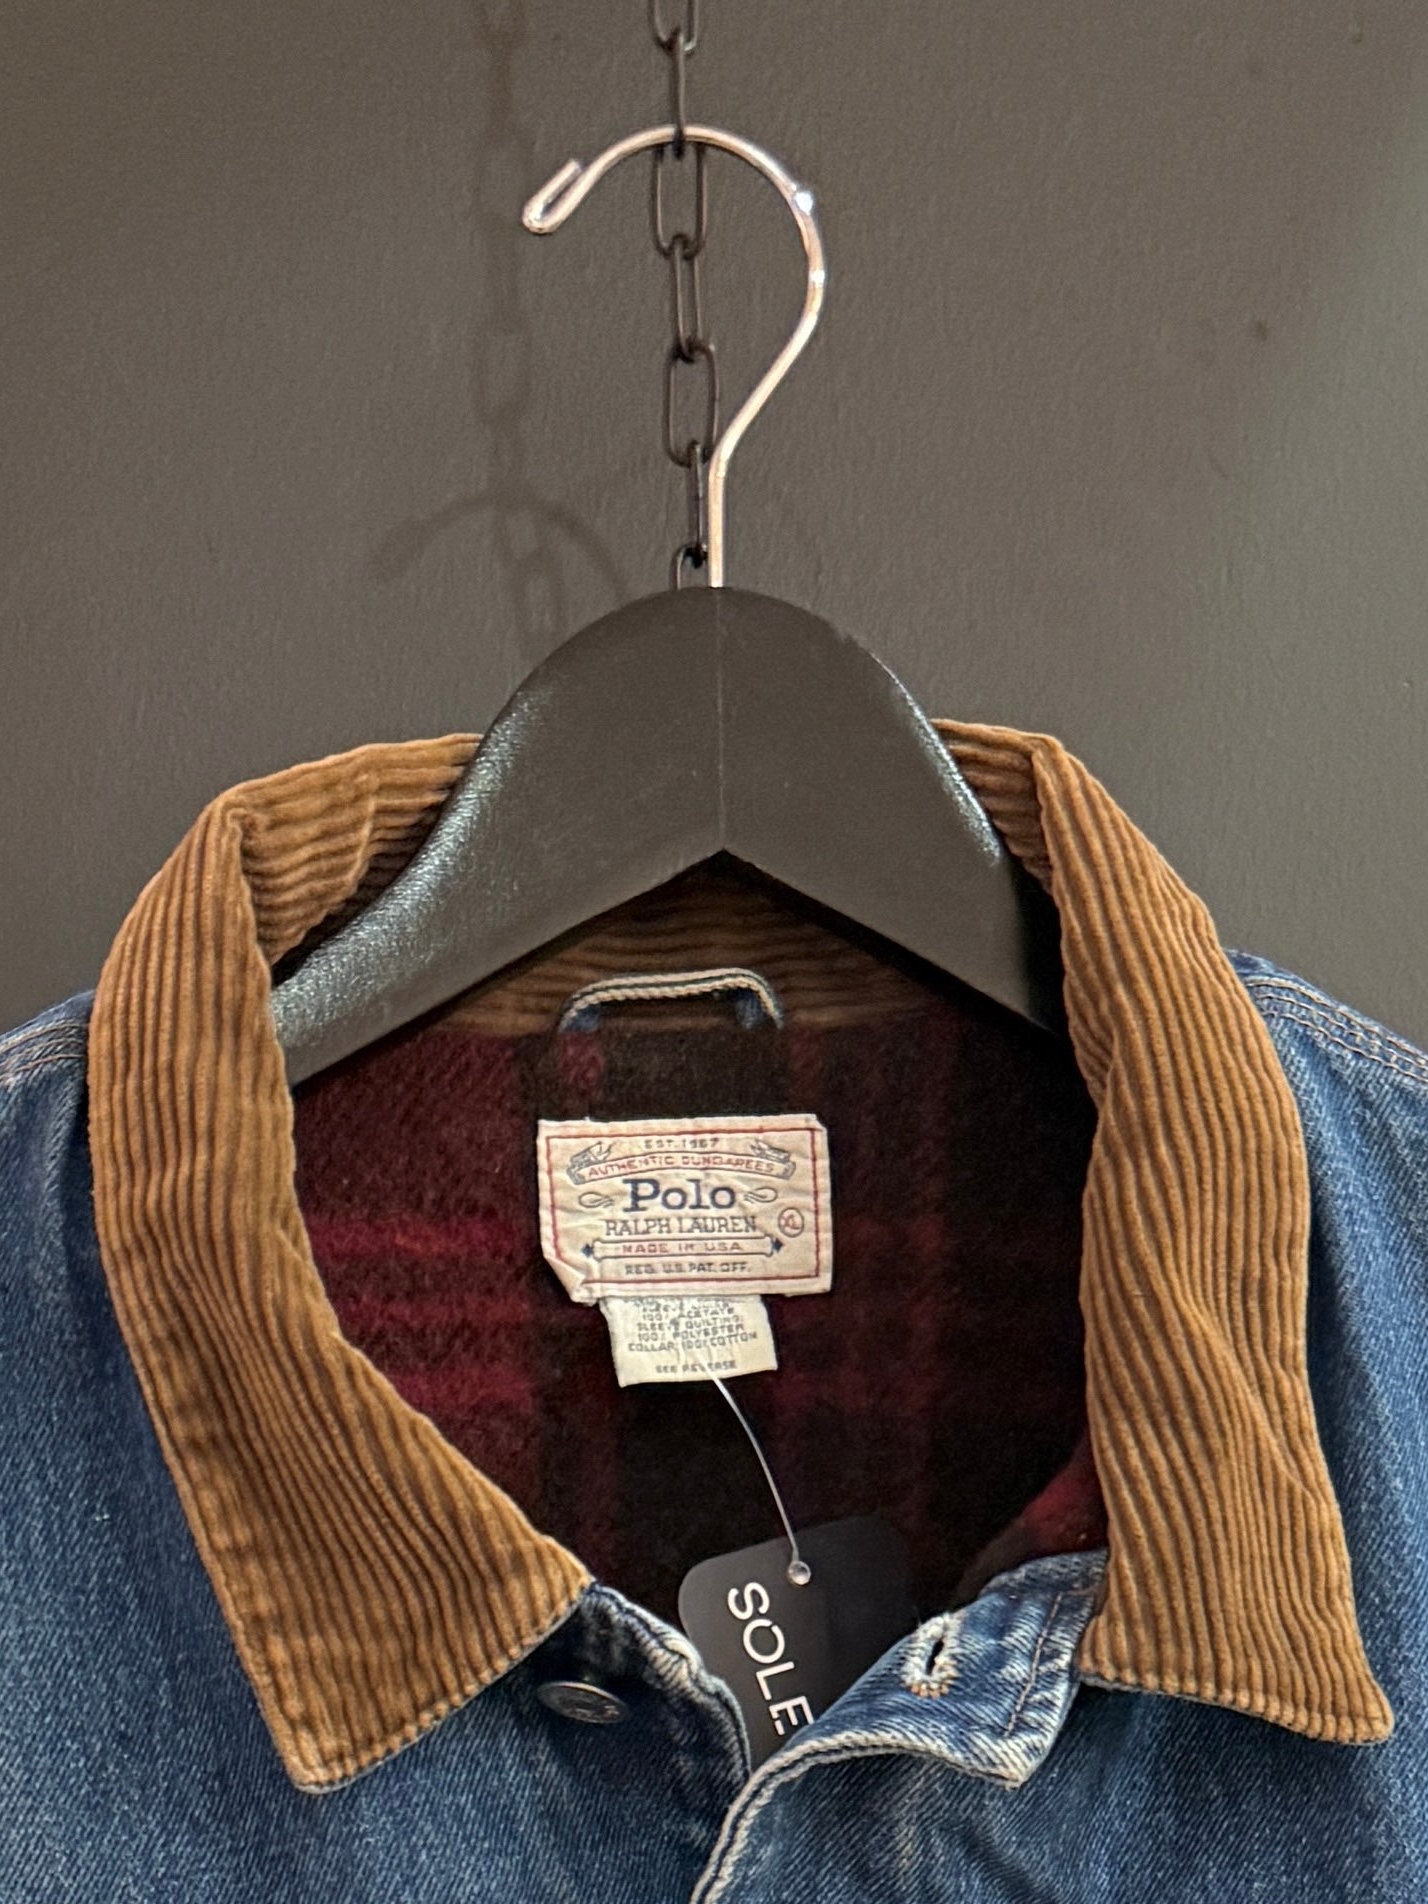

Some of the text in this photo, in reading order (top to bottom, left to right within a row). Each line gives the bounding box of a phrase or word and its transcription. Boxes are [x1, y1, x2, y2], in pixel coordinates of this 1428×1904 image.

[588, 1155, 775, 1178] AUTHENTIC DUNGAREES
[622, 1178, 736, 1213] Polo
[605, 1215, 757, 1236] RALPH LAUREN
[622, 1241, 743, 1254] MADE IN USA
[673, 1323, 744, 1340] POLYESTER
[710, 1331, 757, 1346] COTTON
[727, 1581, 814, 1736] SOLE
